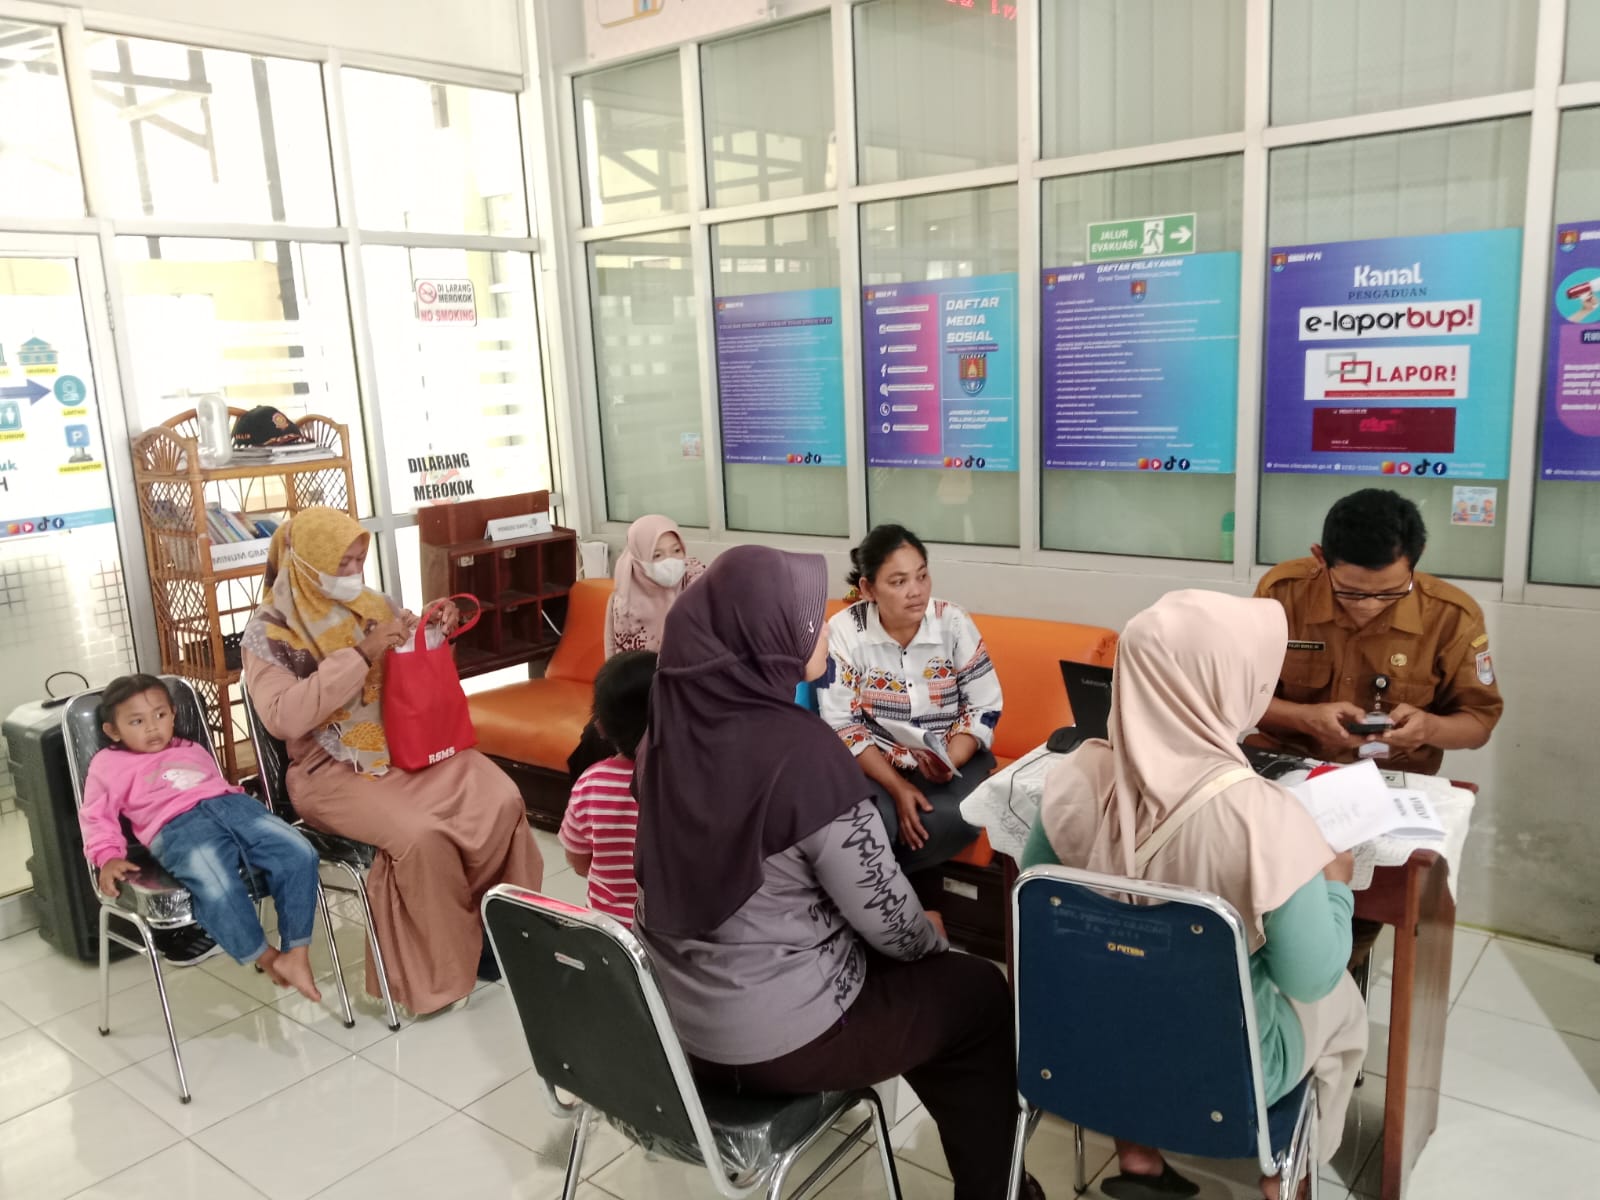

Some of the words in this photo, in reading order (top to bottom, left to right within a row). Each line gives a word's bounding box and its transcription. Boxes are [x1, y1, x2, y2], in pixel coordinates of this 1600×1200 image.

[1100, 229, 1129, 241] JALUR
[1091, 240, 1138, 253] EVAKUASI
[1096, 261, 1130, 273] DAFTAR
[1353, 262, 1424, 288] Kanal
[437, 284, 444, 292] DI
[446, 283, 472, 292] LARANG
[1348, 287, 1428, 300] PENGADUAN
[438, 293, 473, 303] MEROKOK
[945, 297, 1000, 311] DAFTAR
[420, 310, 434, 322] NO
[435, 309, 475, 322] SMOKING
[945, 314, 986, 327] MEDIA
[1305, 303, 1474, 336] e-laporbup!
[945, 331, 993, 343] SOSIAL
[1376, 365, 1457, 383] LAPOR!
[408, 453, 470, 473] DILARANG
[413, 479, 475, 501] MEROKOK
[212, 551, 247, 565] MINUM
